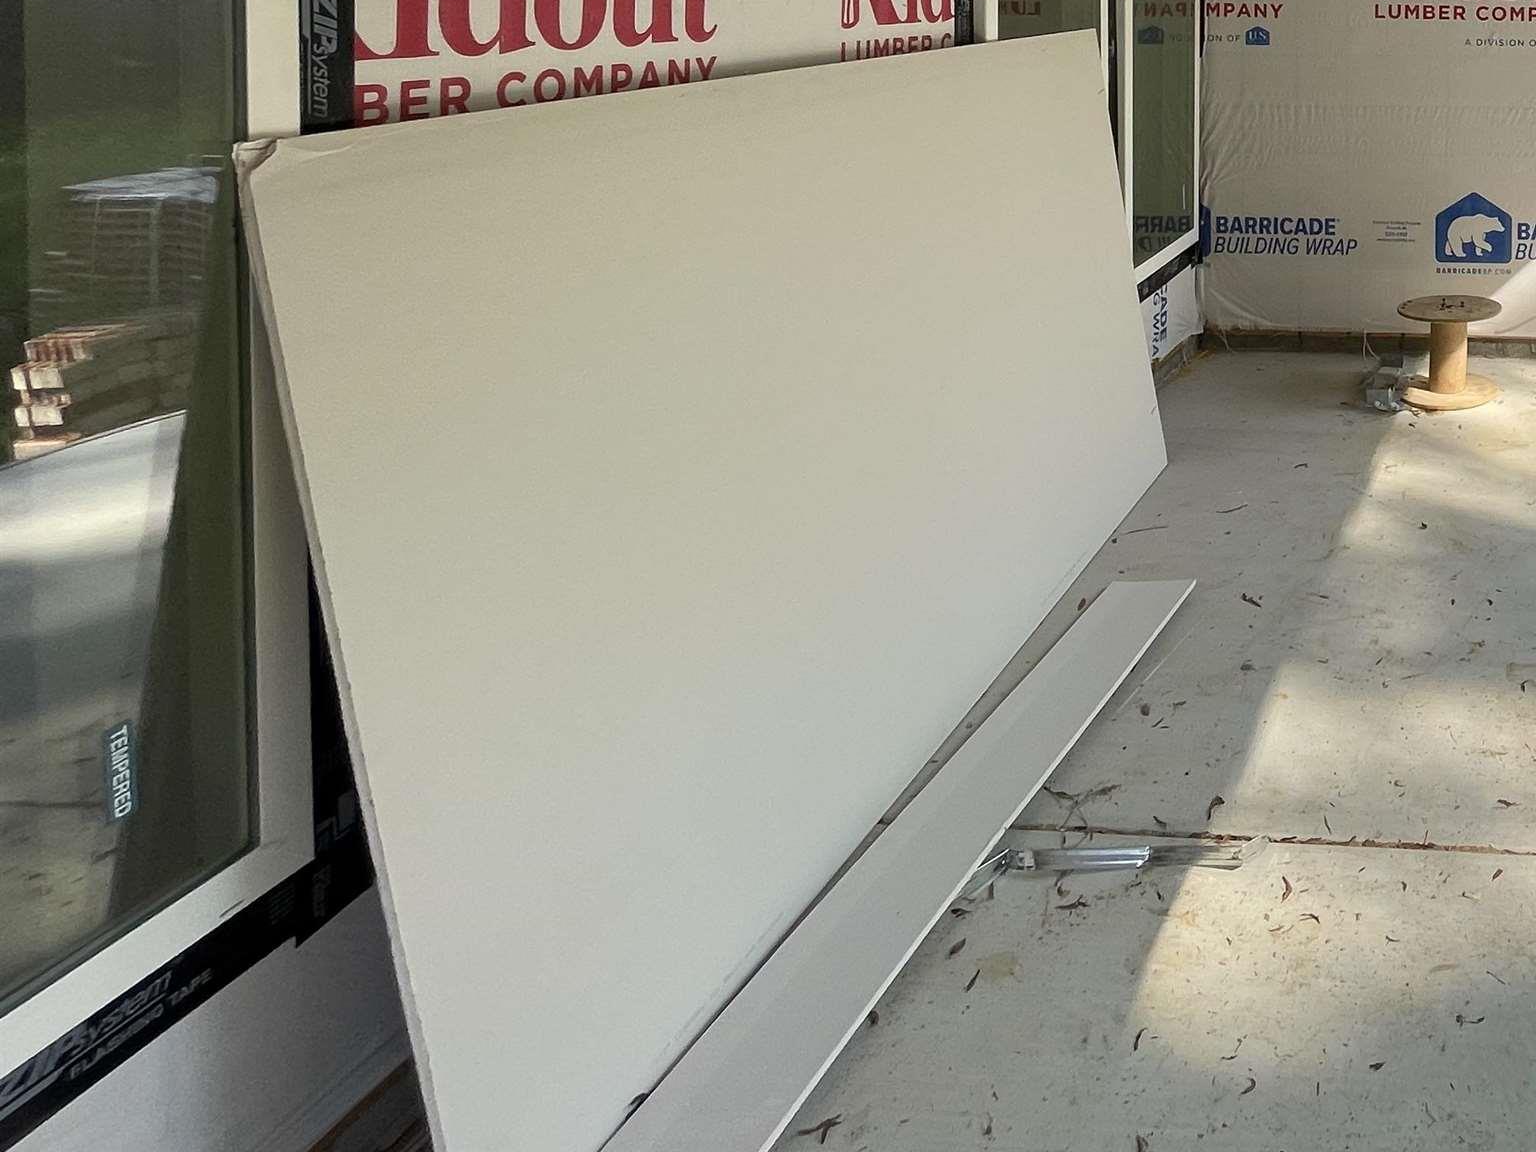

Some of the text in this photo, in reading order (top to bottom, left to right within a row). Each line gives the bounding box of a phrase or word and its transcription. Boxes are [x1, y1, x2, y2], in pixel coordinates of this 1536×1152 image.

[1206, 2, 1284, 19] MPANY
[1374, 3, 1466, 20] LUMBER
[1464, 37, 1472, 46] A
[1476, 37, 1525, 47] DIVISION
[354, 55, 718, 130] BER COMPANY
[1215, 215, 1336, 236] BARRICADE
[1214, 237, 1358, 256] BUILDING WRAP
[110, 724, 132, 818] TEMPERED
